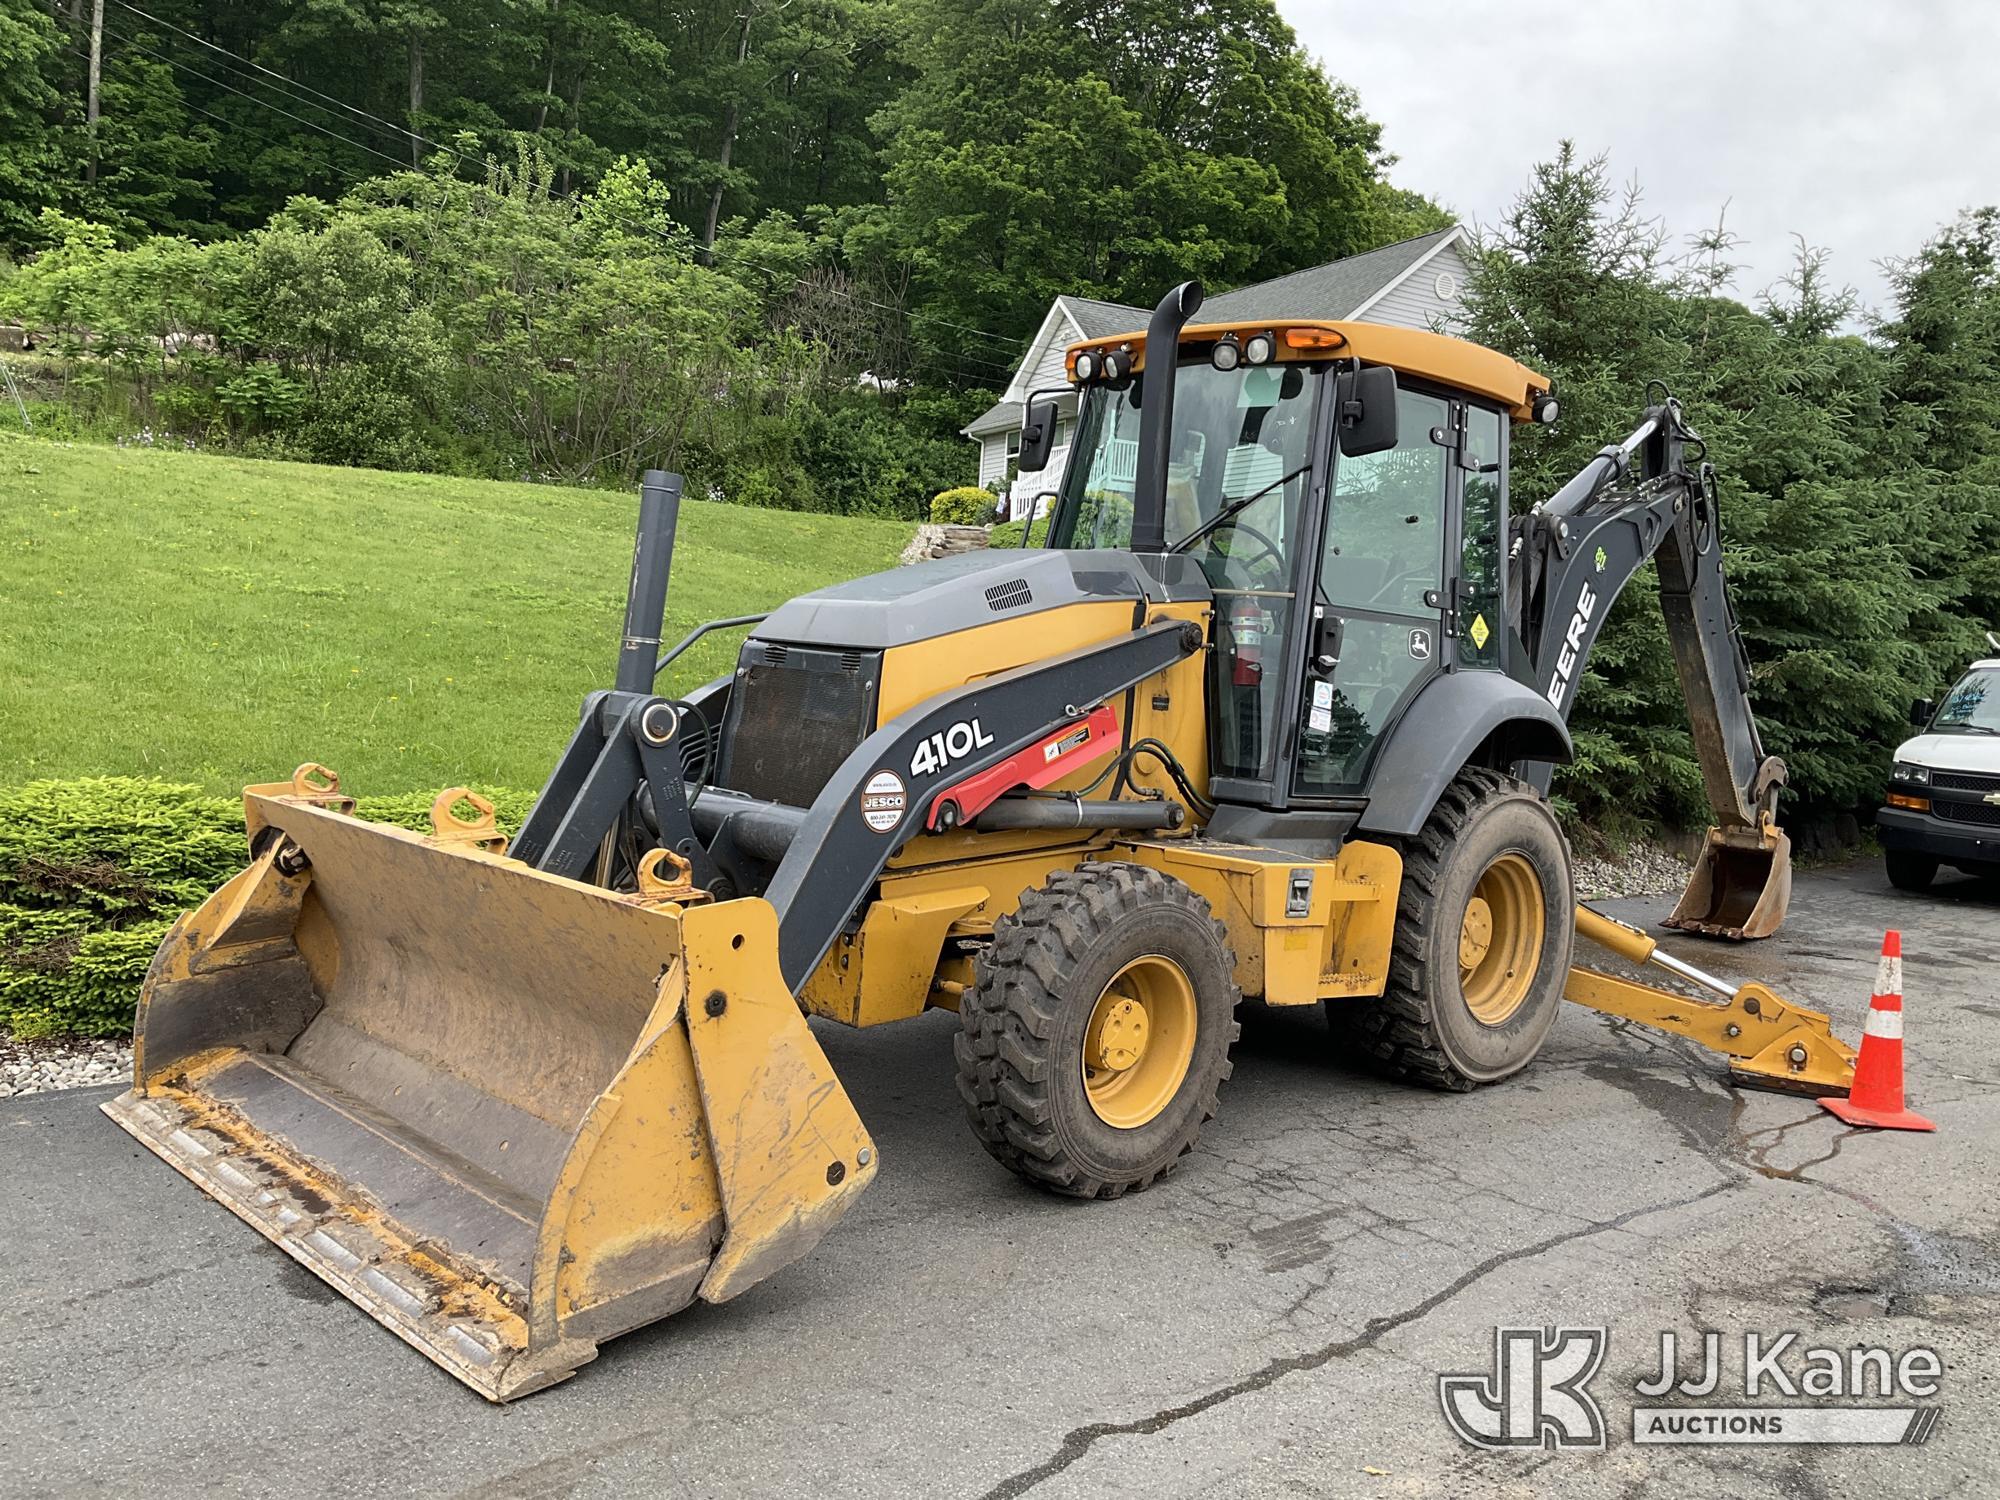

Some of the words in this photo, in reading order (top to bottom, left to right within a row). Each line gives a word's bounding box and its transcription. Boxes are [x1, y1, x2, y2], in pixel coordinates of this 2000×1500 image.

[1547, 580, 1597, 711] EERE
[910, 718, 995, 777] 410L
[865, 796, 903, 808] JESCO
